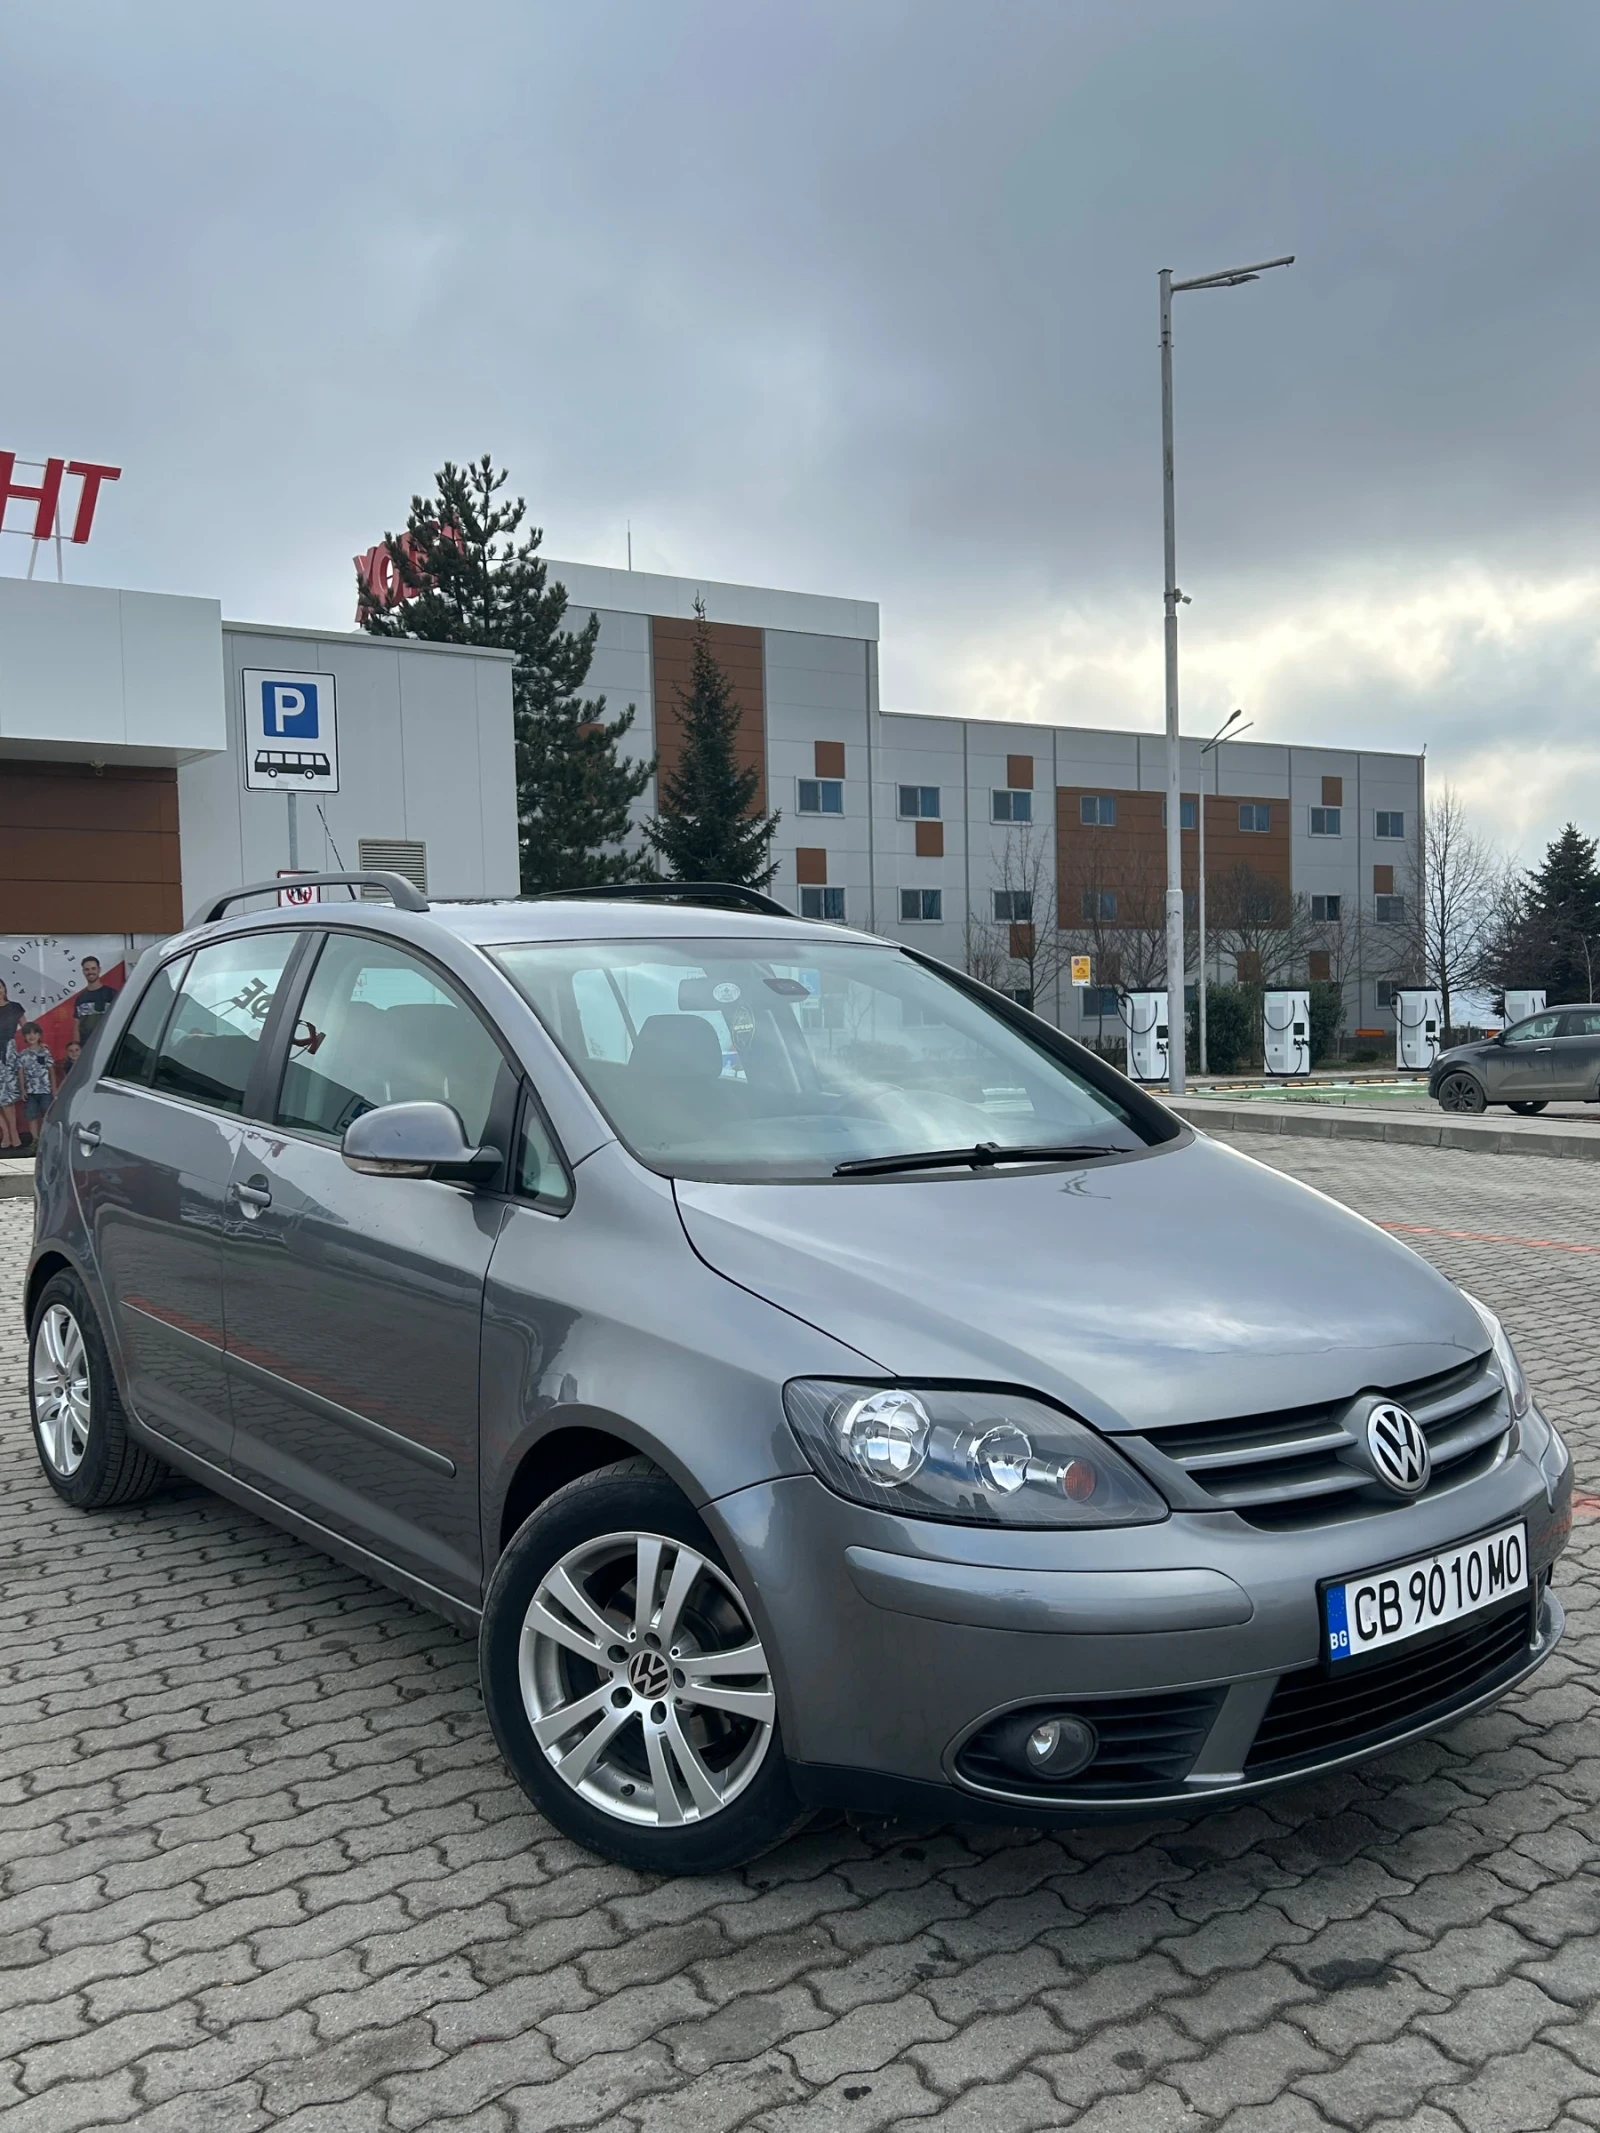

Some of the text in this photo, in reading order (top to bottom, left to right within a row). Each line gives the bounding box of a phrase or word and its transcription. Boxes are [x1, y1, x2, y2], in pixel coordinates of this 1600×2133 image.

[274, 686, 306, 733] P
[12, 939, 58, 963] OUTLET
[31, 980, 76, 1004] OUTLET
[1354, 1534, 1522, 1641] CB 9010 MO
[1329, 1630, 1348, 1650] BG
